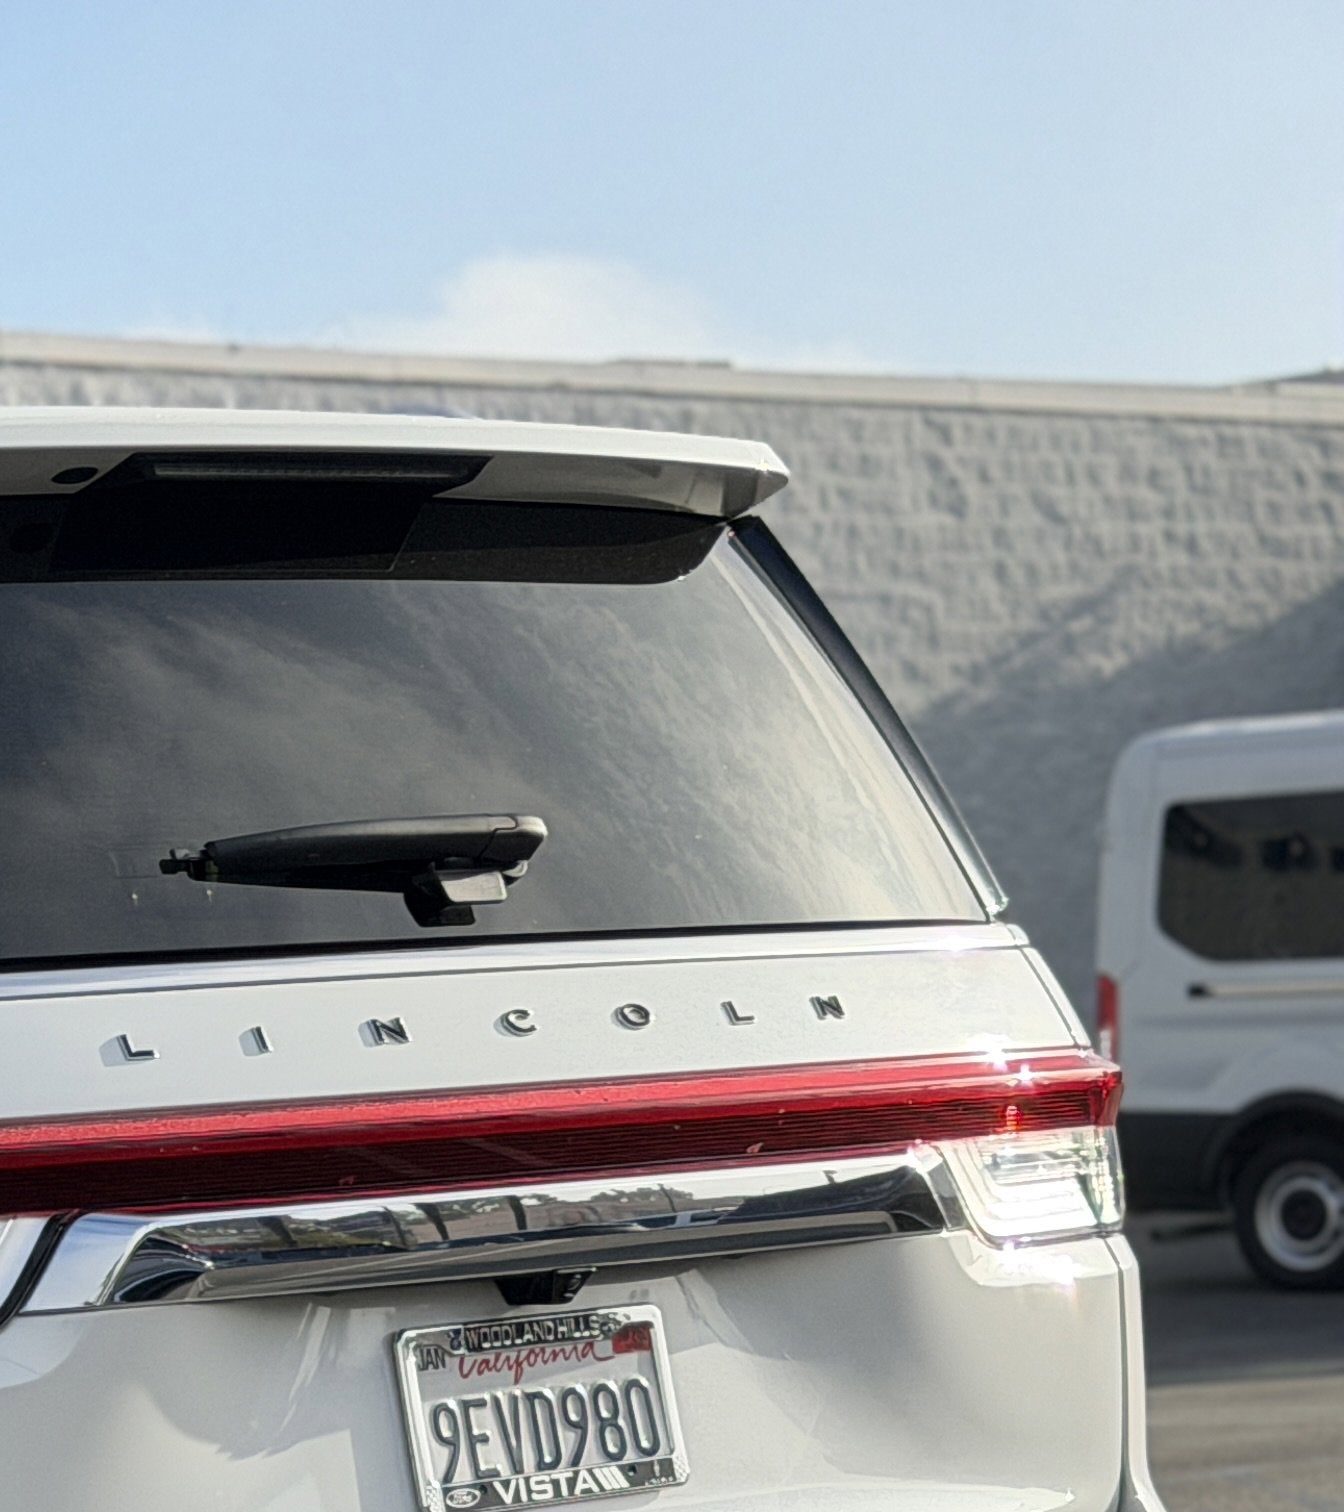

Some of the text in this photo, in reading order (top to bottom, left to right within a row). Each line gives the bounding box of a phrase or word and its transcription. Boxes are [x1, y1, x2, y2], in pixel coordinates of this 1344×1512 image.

[119, 993, 846, 1062] LINCOLN
[467, 1322, 555, 1347] WOODLAND
[557, 1315, 603, 1341] HILLS
[418, 1346, 446, 1372] JAN
[459, 1342, 614, 1384] California
[433, 1375, 661, 1485] 9EVD980
[494, 1470, 601, 1505] VISTA
